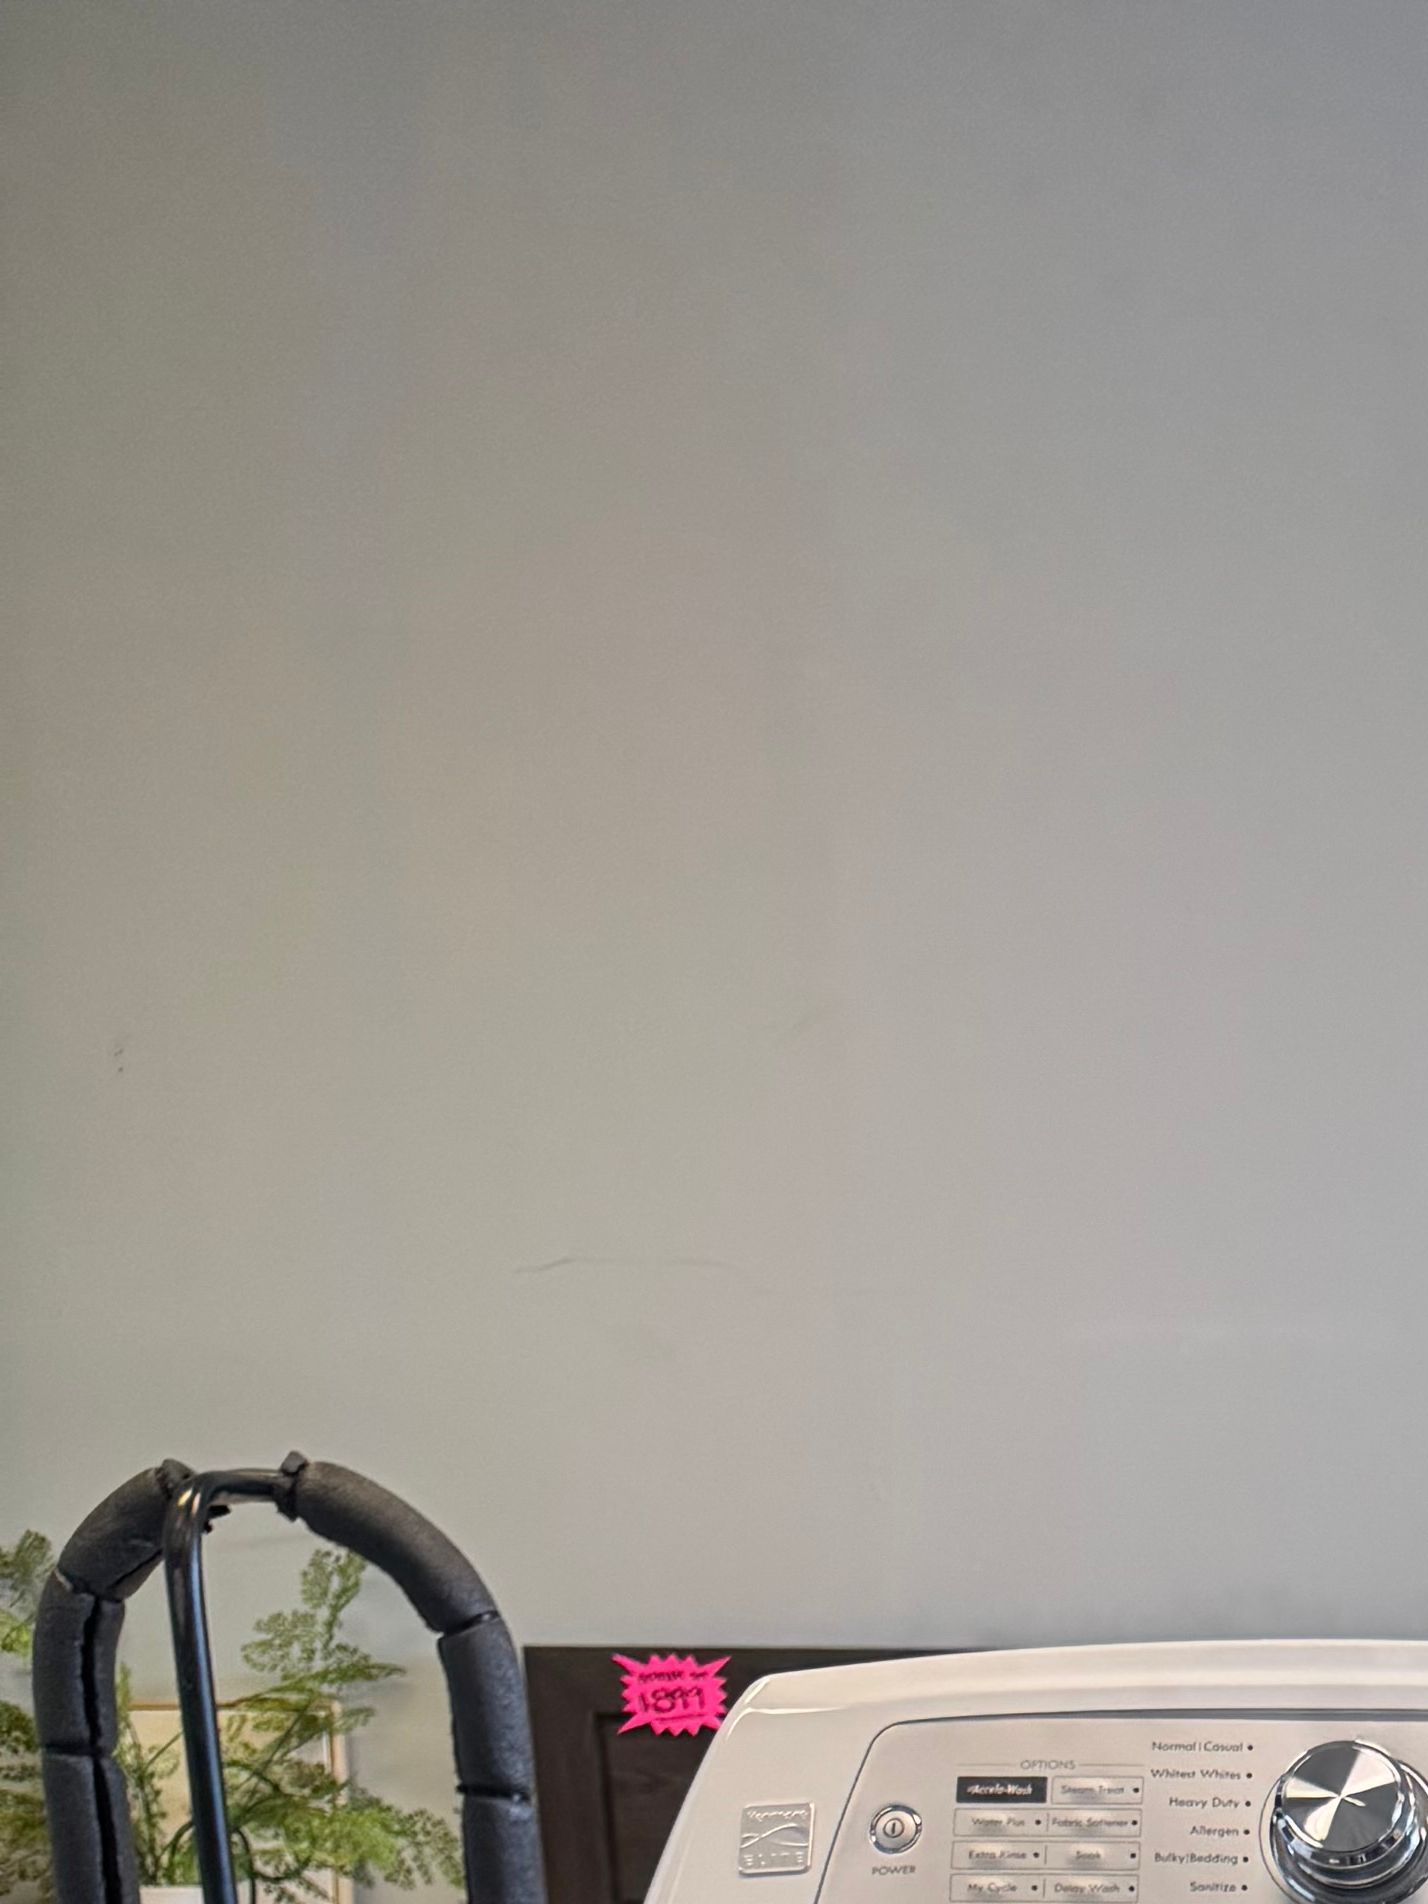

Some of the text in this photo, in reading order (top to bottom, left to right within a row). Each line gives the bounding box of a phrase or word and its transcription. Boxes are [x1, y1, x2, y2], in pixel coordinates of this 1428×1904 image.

[1020, 1759, 1076, 1770] OPTIONS
[1150, 1768, 1241, 1780] Whitest Whites
[1169, 1796, 1240, 1809] Heavy Duty
[1190, 1826, 1239, 1838] Allergen
[968, 1850, 1027, 1860] Extra Rinse
[872, 1865, 916, 1875] POWER
[987, 1882, 1017, 1894] Cycle
[1088, 1883, 1120, 1893] Wash
[1190, 1881, 1236, 1892] Sanitize
